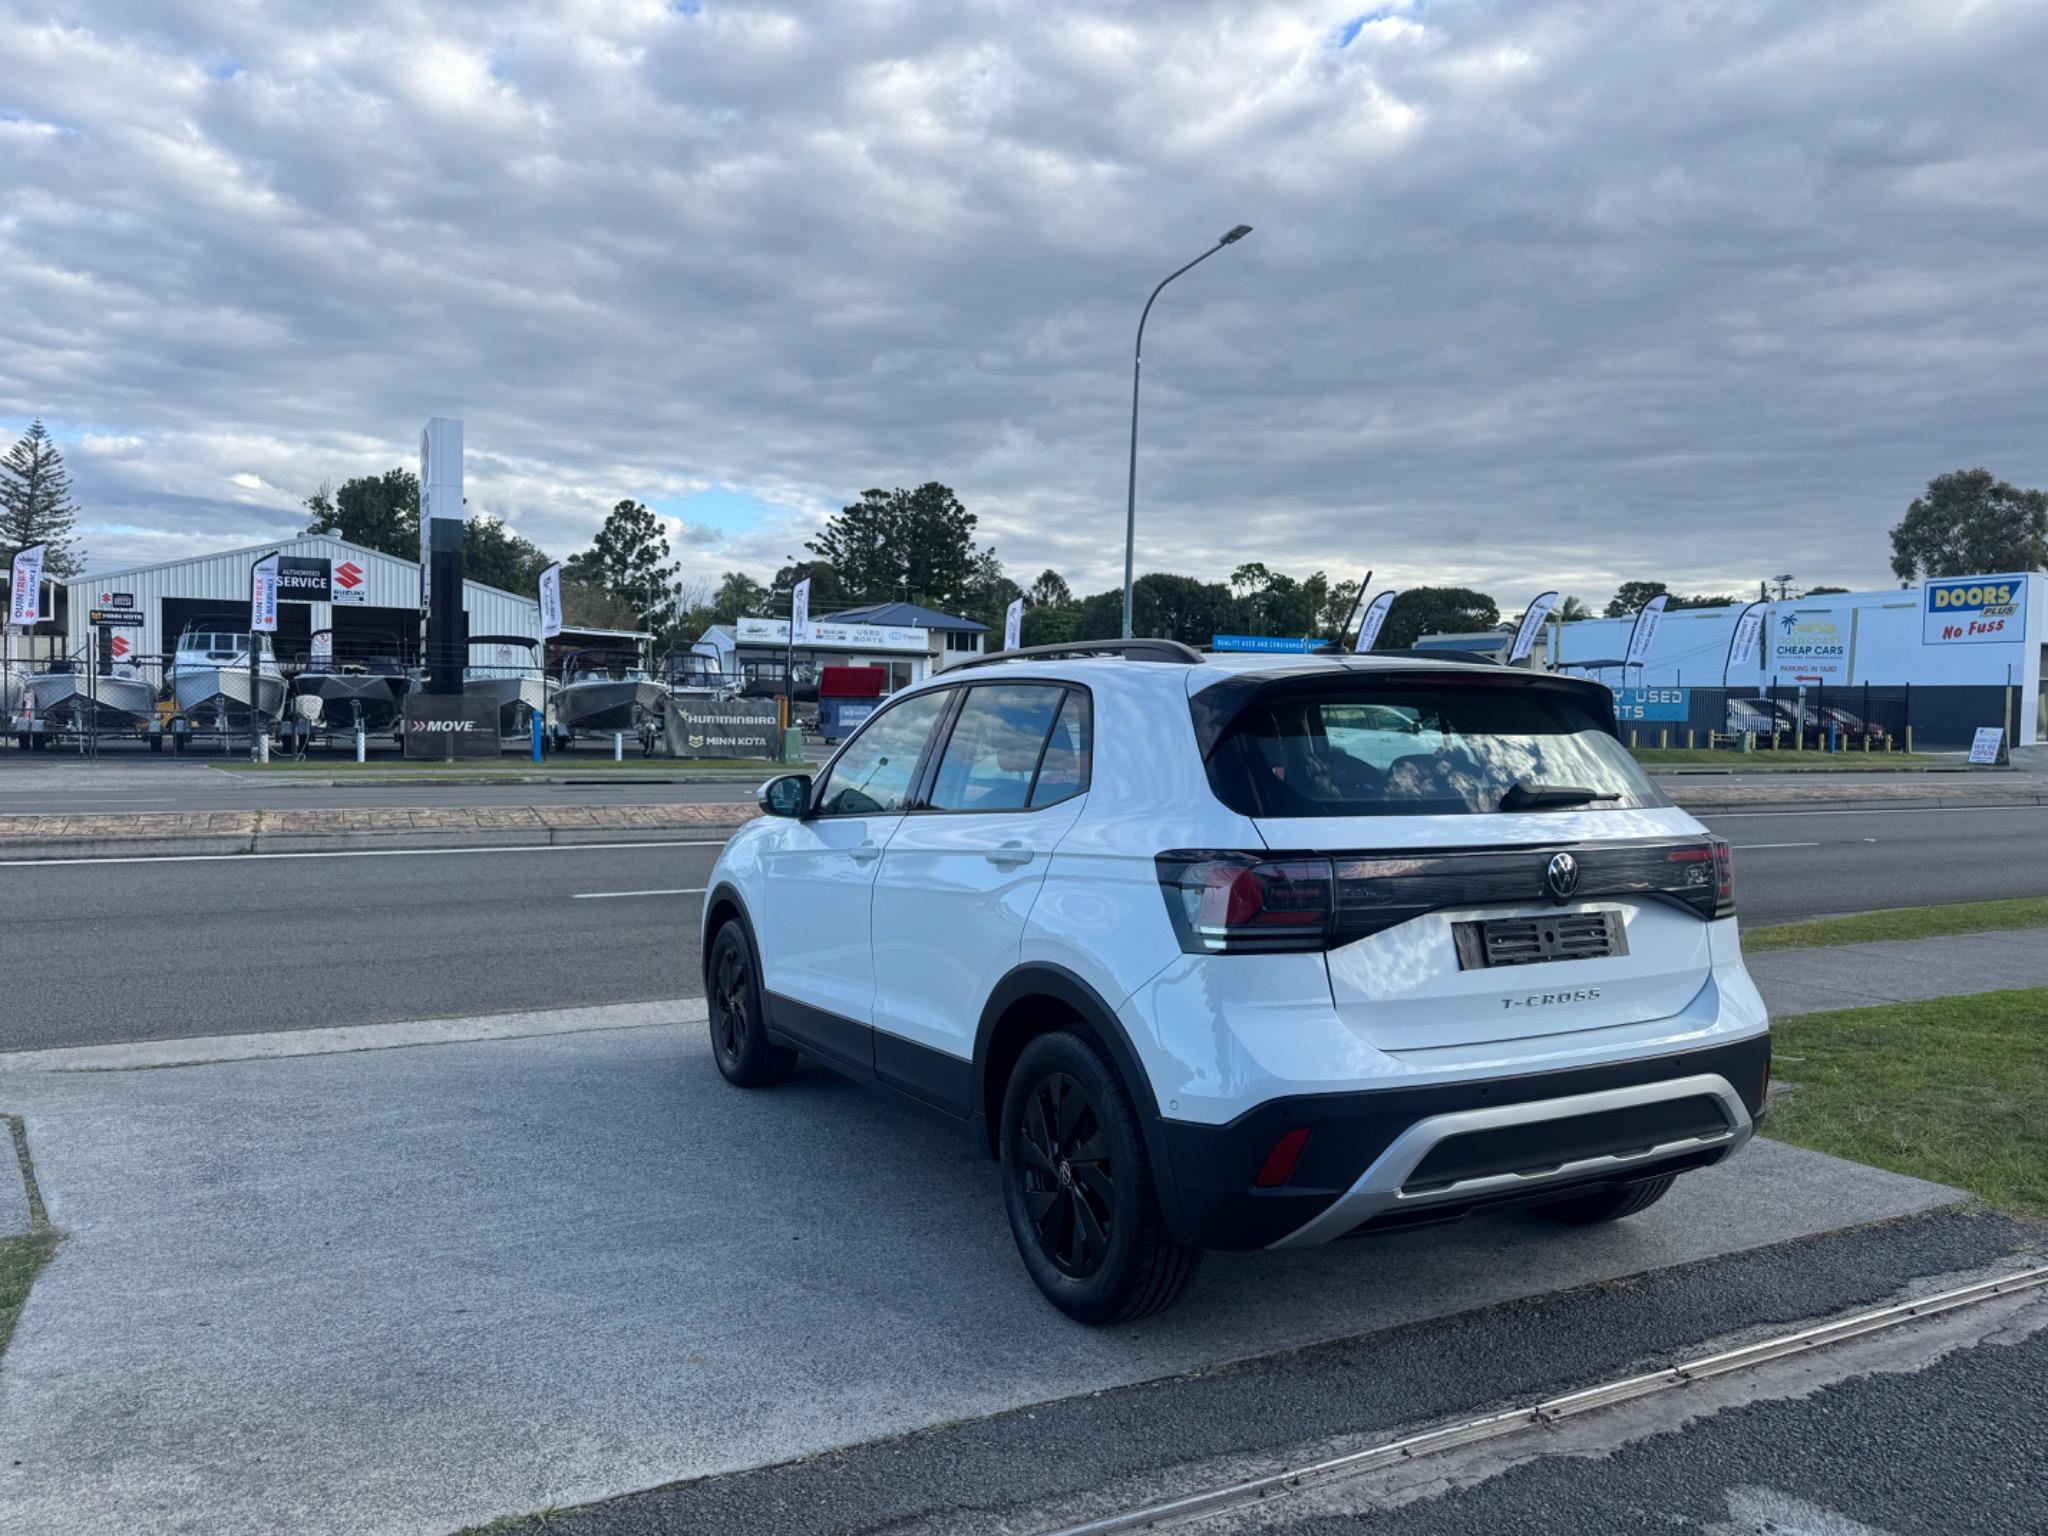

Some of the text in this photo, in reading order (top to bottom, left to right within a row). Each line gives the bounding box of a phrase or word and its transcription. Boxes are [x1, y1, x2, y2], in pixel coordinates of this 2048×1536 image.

[282, 569, 321, 577] AUTHORISED
[28, 570, 38, 608] SUZUKI
[276, 576, 328, 589] SERVICE
[14, 568, 26, 618] QUINTREX
[266, 578, 274, 615] SUZUKI
[1935, 585, 2010, 607] DOORS
[254, 578, 264, 624] QUINTREX
[1984, 606, 2014, 616] PLUS
[1942, 625, 1963, 640] No
[1776, 646, 1844, 655] CHEAP CARS
[1819, 665, 1838, 673] YARD
[1635, 690, 1682, 704] USED
[1613, 705, 1645, 718] ATS
[426, 720, 475, 732] MOVE
[687, 714, 777, 726] HUMMINBIRD
[706, 736, 767, 746] MINN KOTA
[1500, 987, 1601, 1009] T-CROSS
